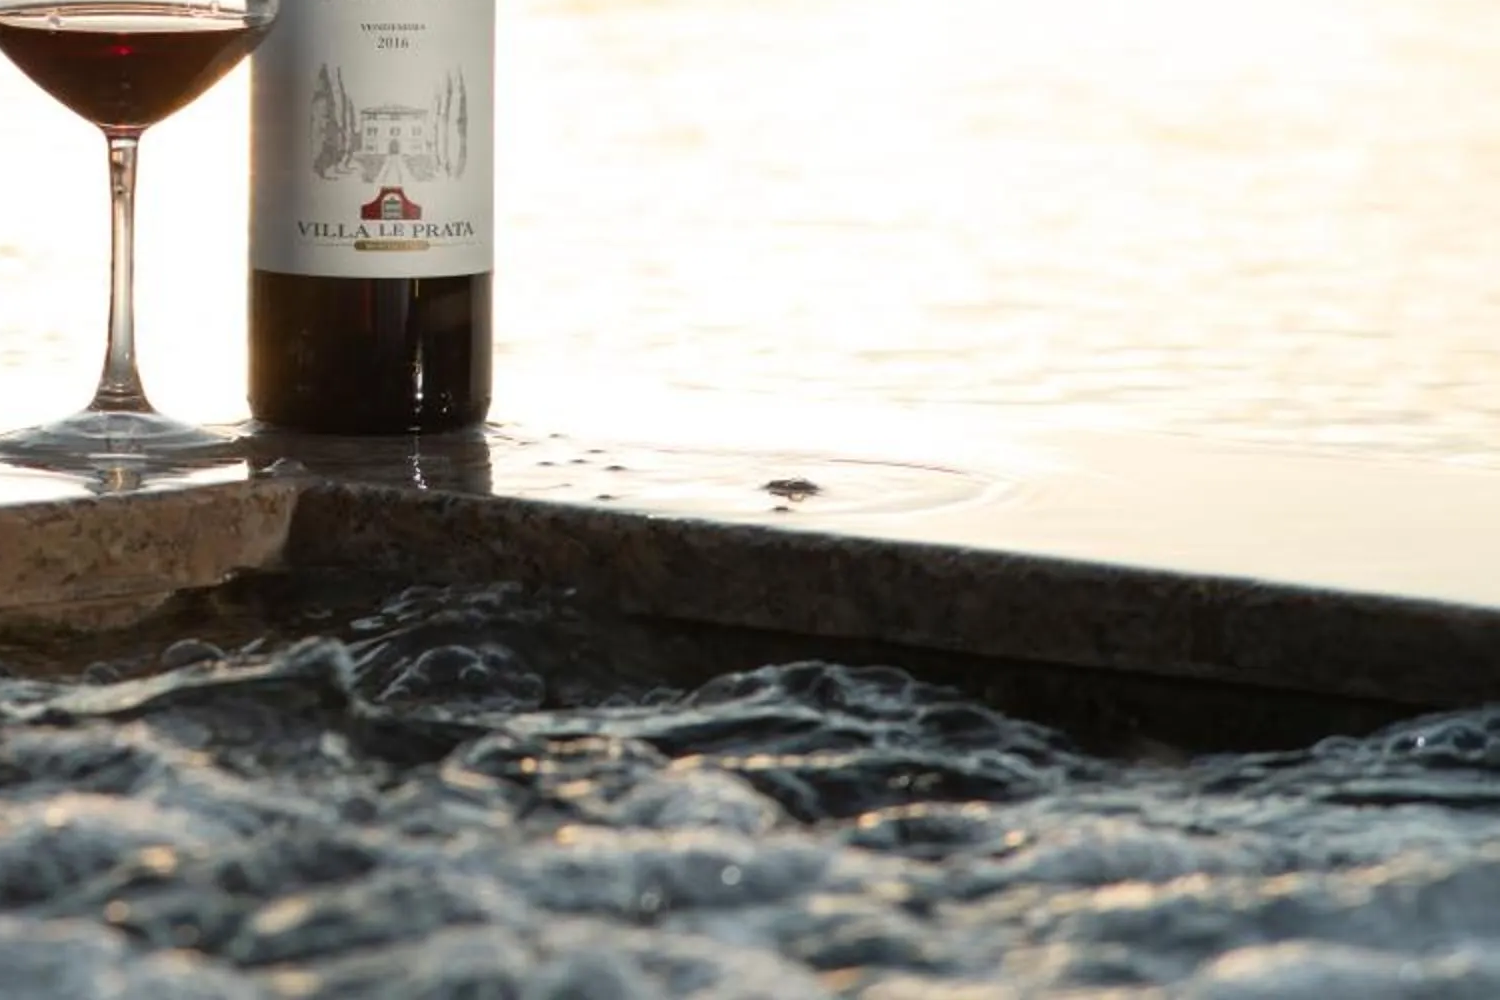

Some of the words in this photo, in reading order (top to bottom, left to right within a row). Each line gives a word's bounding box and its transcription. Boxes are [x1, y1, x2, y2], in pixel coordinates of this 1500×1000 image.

[377, 36, 409, 49] 2016
[297, 220, 370, 238] VILLA
[379, 221, 405, 237] LE
[412, 220, 475, 238] PRATA
